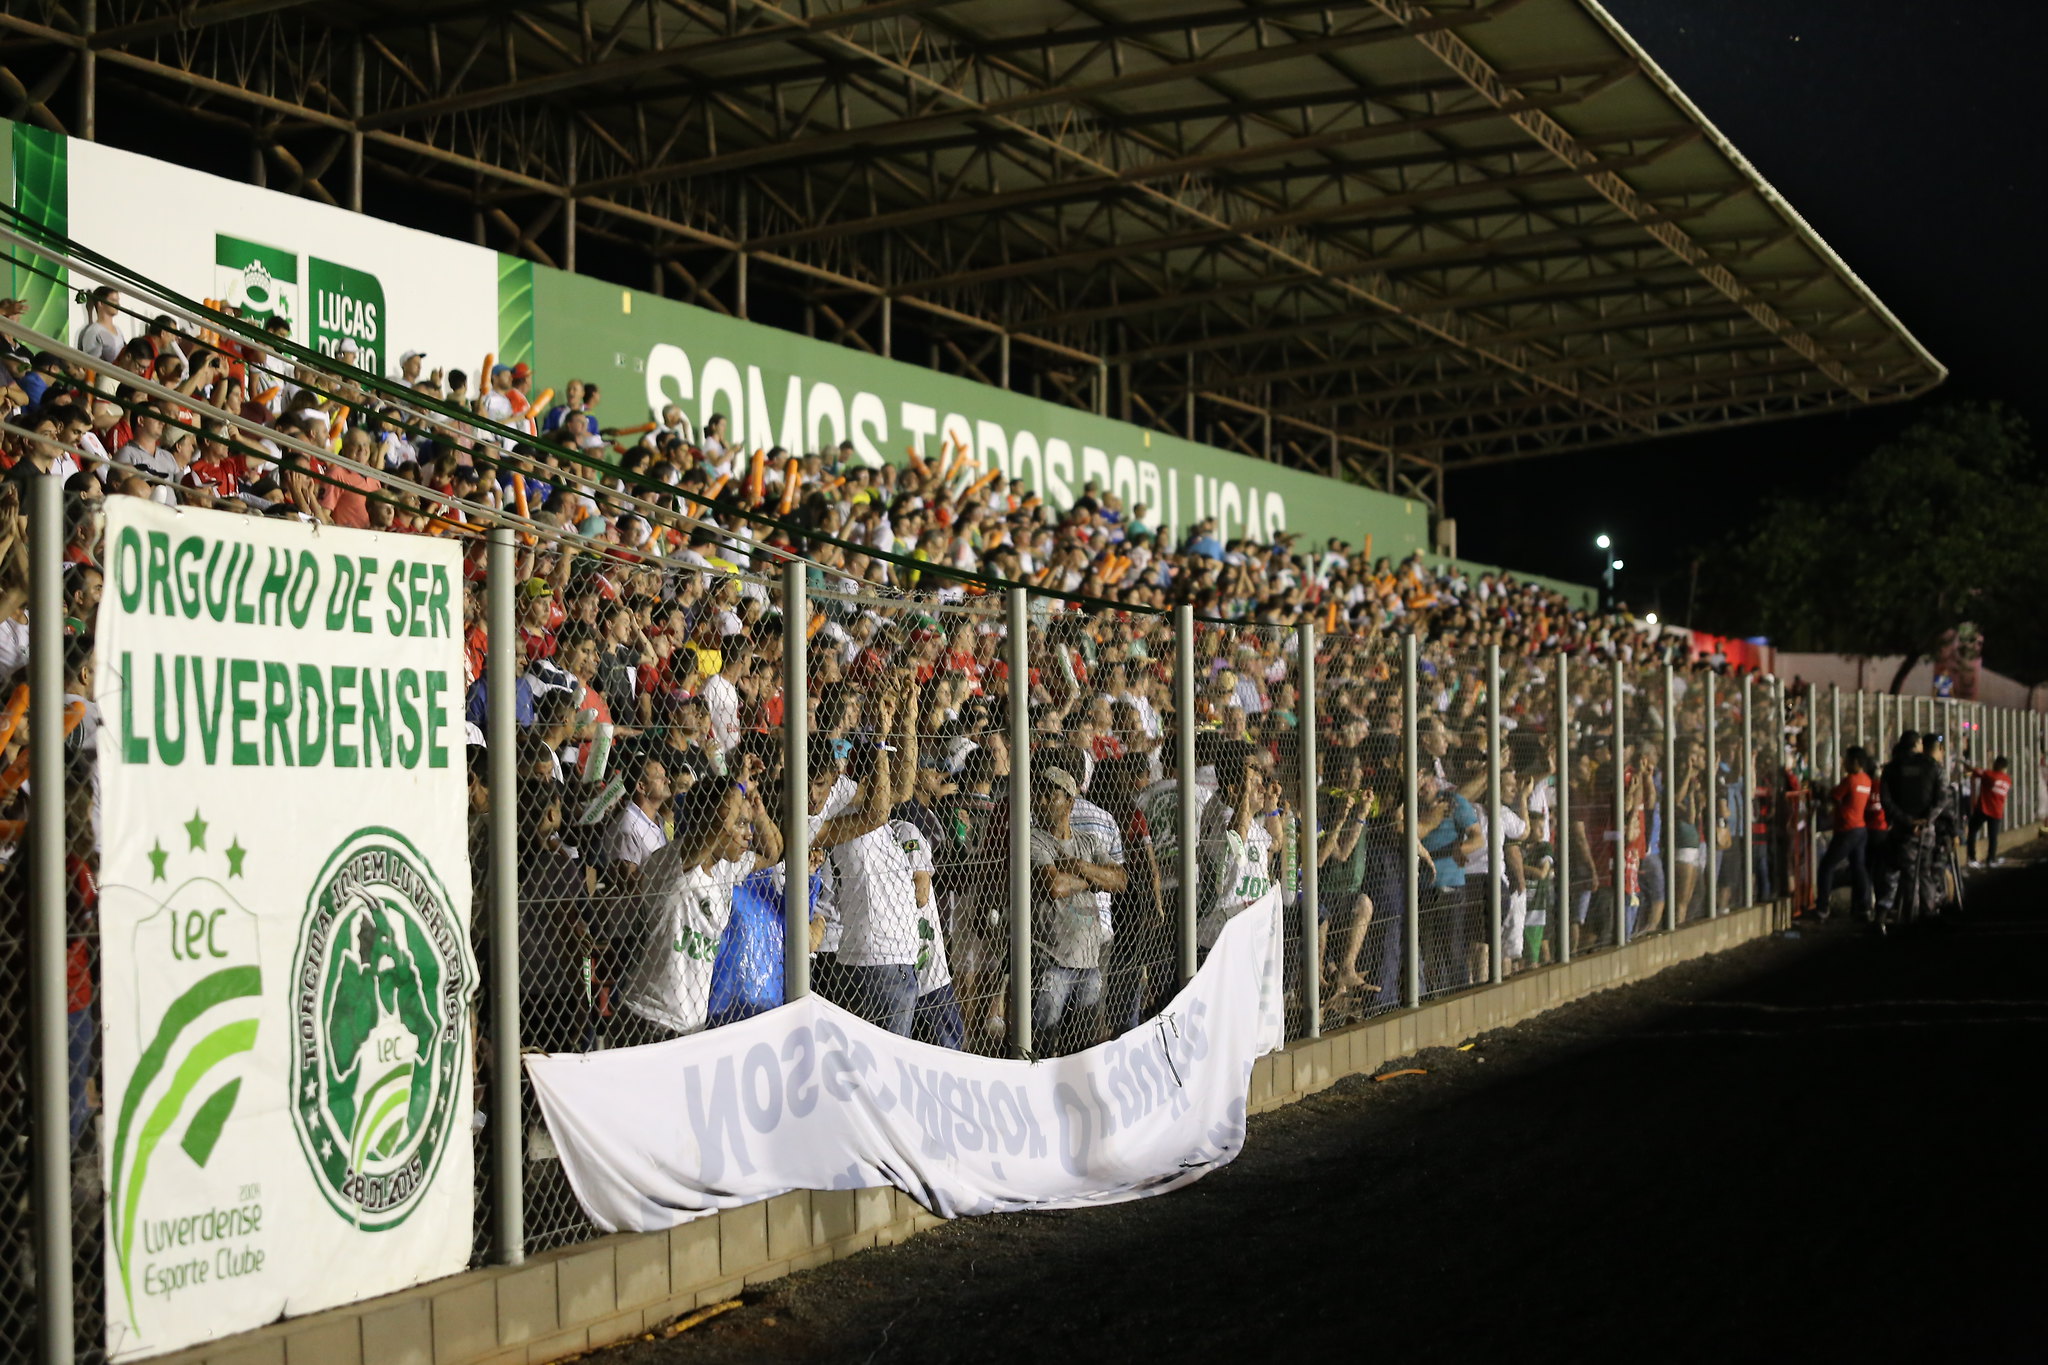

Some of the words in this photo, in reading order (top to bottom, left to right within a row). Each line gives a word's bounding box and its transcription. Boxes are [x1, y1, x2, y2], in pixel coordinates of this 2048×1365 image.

[318, 288, 377, 342] LUCAS
[645, 342, 888, 482] SOMOS
[902, 401, 1074, 522] TODOS
[1168, 468, 1287, 554] LUCAS
[115, 524, 319, 630] ORGULHO
[326, 553, 378, 634] DE
[386, 559, 451, 639] SER
[121, 650, 449, 771] LUVERDENSE
[302, 905, 335, 1069] TORCIDA
[332, 851, 388, 912] JOVEM
[390, 856, 463, 1042] LUVERDENSE
[143, 1257, 210, 1303] Esporte
[215, 1243, 266, 1280] Clube
